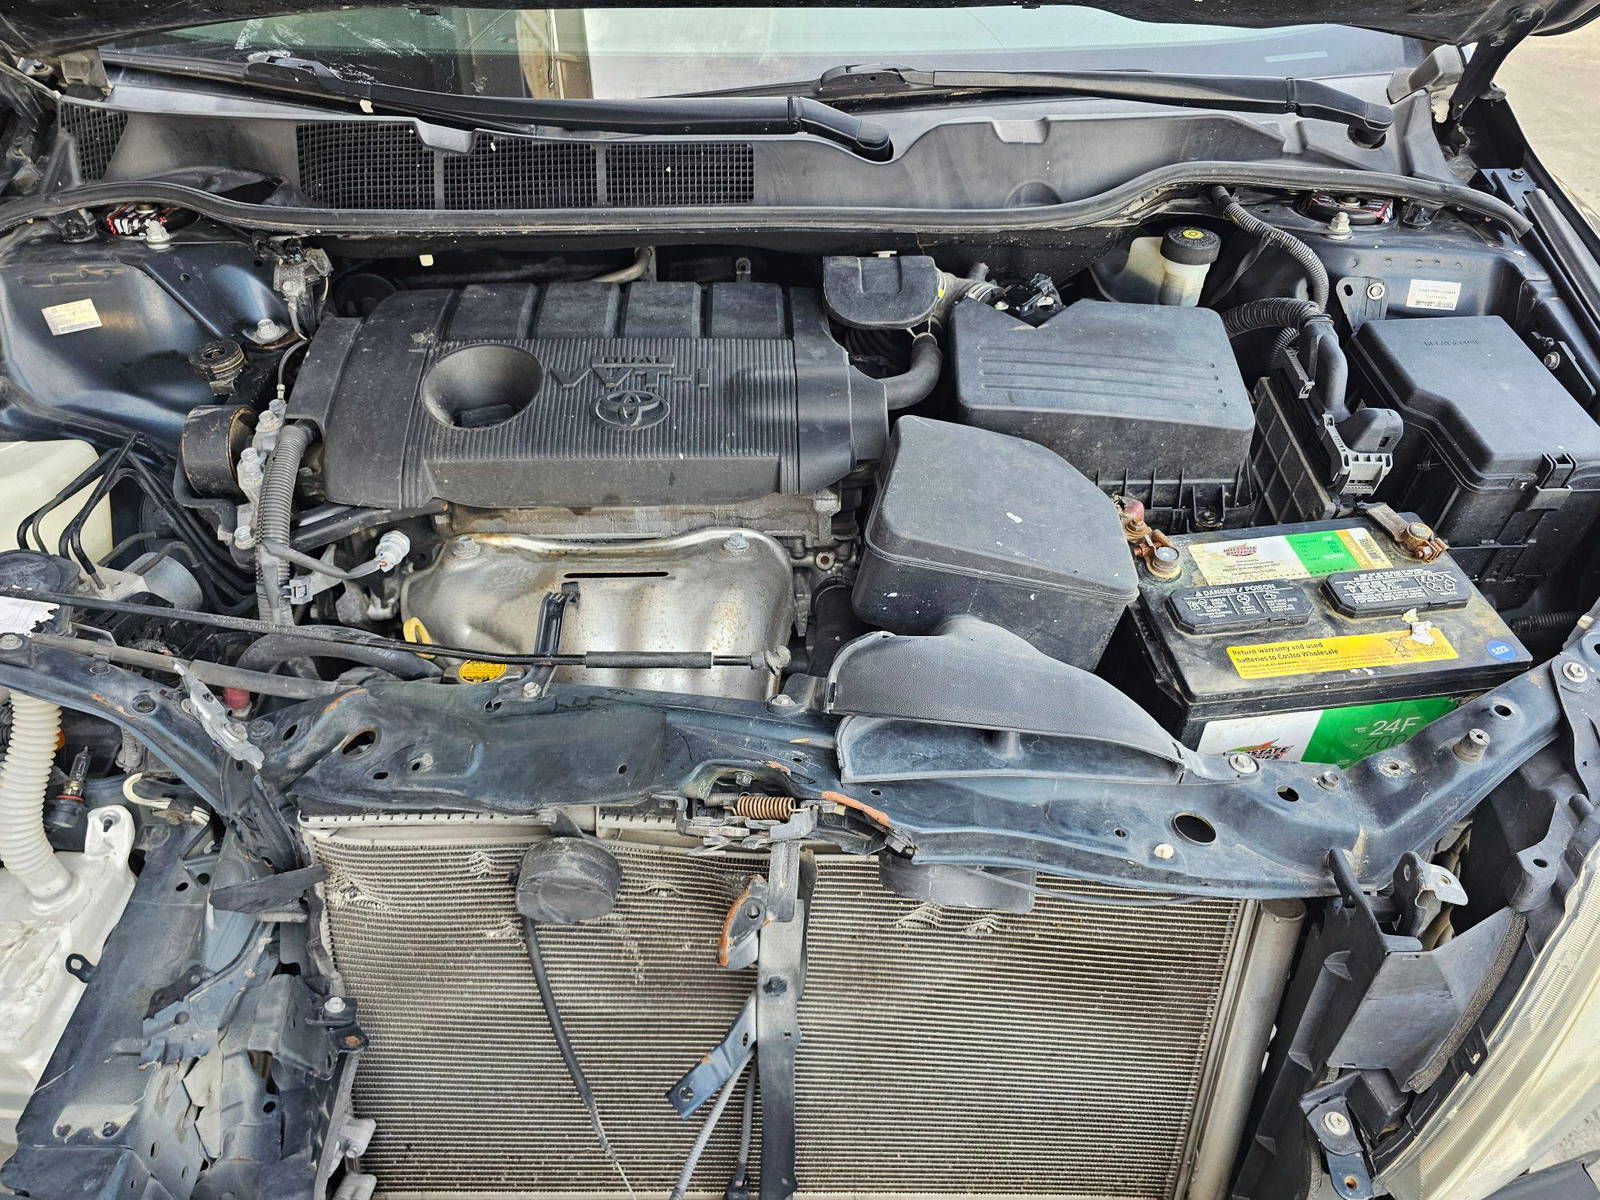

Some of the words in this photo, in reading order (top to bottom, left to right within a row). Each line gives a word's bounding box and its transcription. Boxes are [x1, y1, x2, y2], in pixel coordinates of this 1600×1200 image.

[1203, 588, 1237, 596] DANGER
[1244, 584, 1276, 592] POISON
[1232, 648, 1257, 656] Return
[1259, 646, 1290, 654] warranty
[1236, 655, 1268, 663] batteries
[1278, 652, 1301, 660] Costco
[1302, 648, 1339, 657] Wholesale
[1368, 717, 1420, 736] 24F
